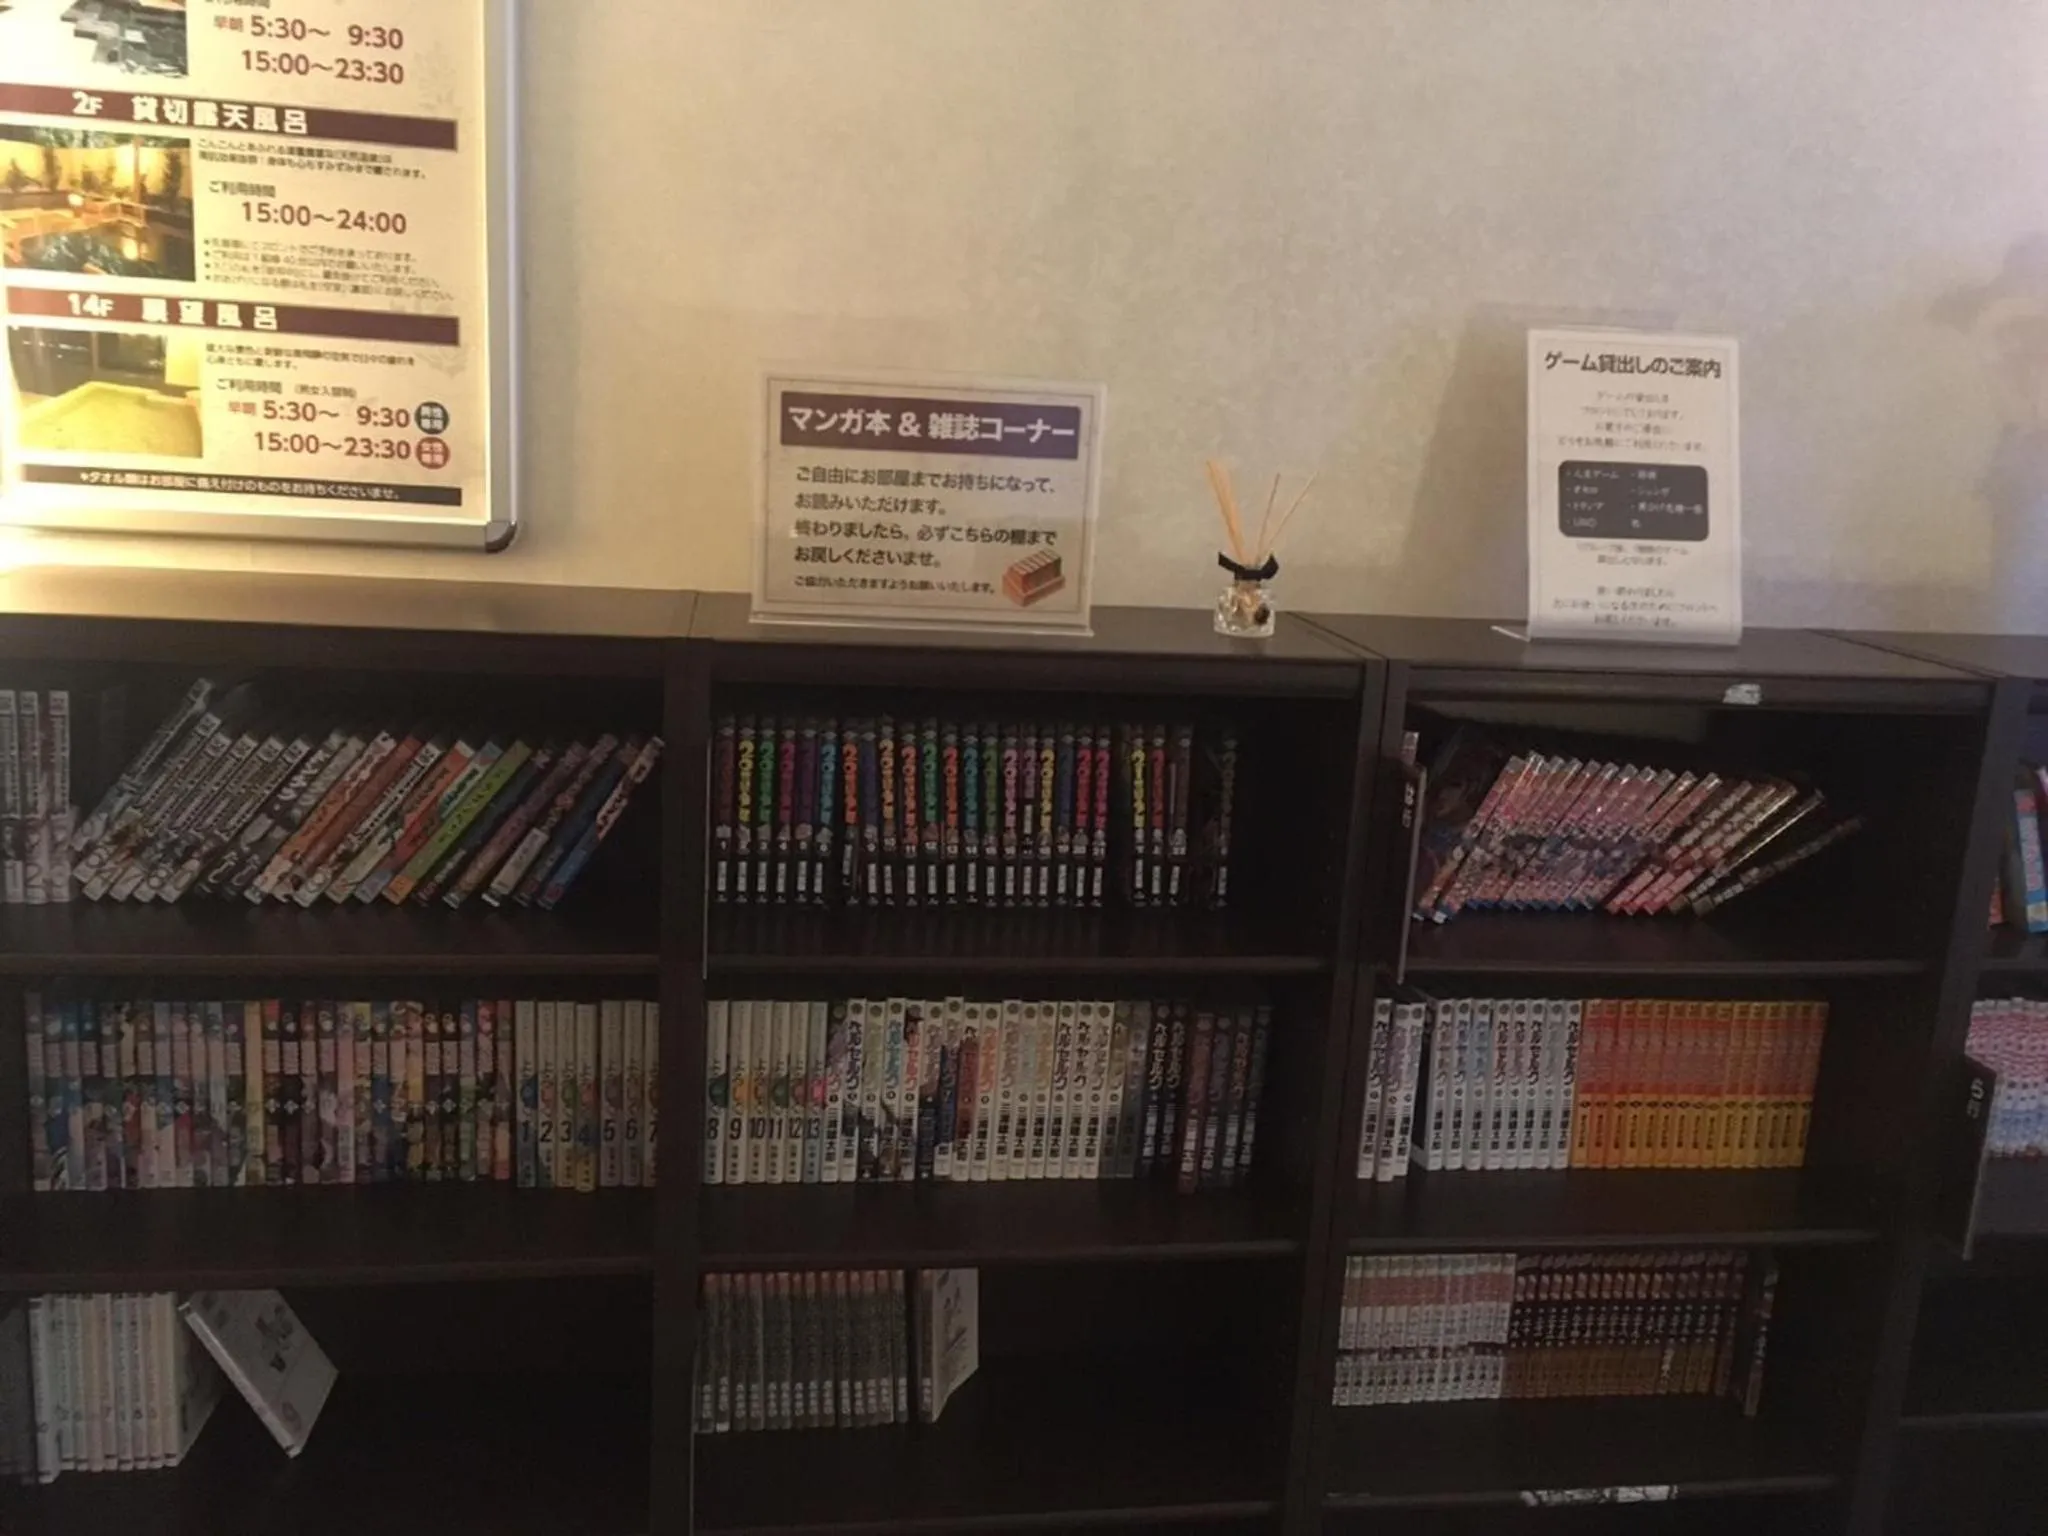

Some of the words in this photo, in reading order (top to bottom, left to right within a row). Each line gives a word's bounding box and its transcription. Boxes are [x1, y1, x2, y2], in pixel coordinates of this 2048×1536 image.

[347, 25, 404, 49] 9:30
[72, 91, 104, 115] 2F
[69, 293, 114, 316] 14F
[1545, 350, 1722, 379] ゲーム貸出しのご案内
[356, 405, 411, 429] 9:30
[789, 405, 893, 437] マンガ本
[898, 412, 923, 439] &
[928, 411, 1076, 444] 雑誌コーナー
[795, 492, 946, 516] お読みいただけます。
[795, 546, 942, 568] お戻しくださいませ。
